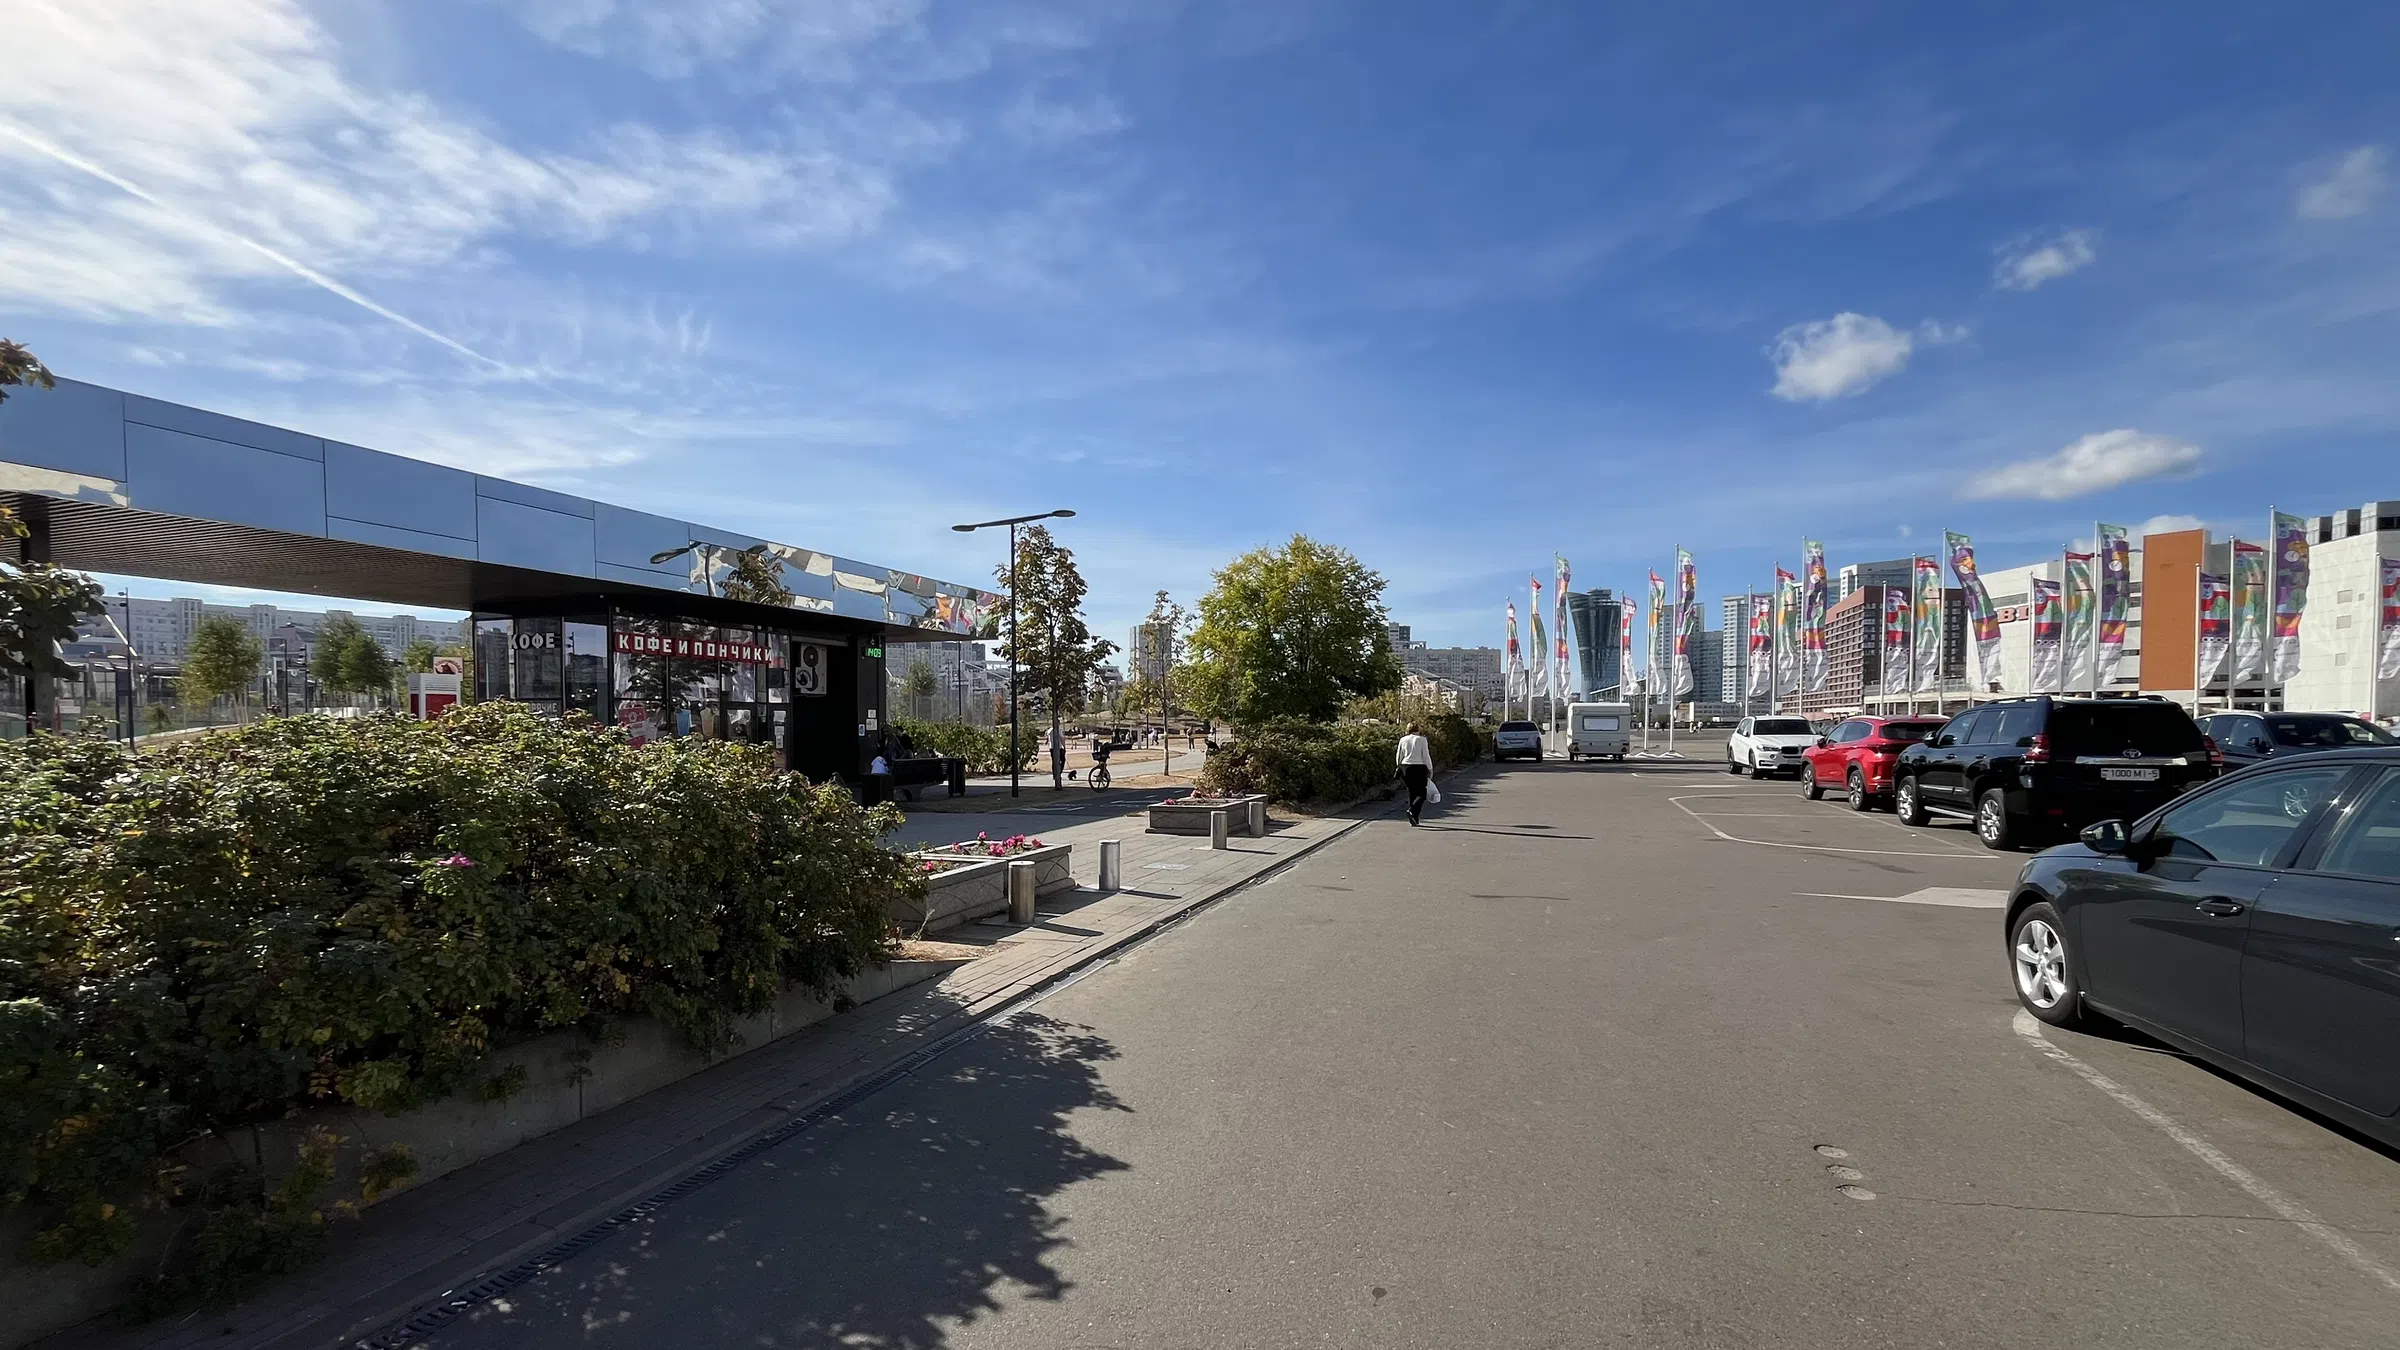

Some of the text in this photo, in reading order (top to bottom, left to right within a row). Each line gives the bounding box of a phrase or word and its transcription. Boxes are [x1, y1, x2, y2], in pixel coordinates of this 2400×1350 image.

[508, 633, 555, 649] КОФЕ
[619, 634, 773, 662] КОФЕ И ПОНЧИКИ
[2111, 769, 2132, 778] 1000
